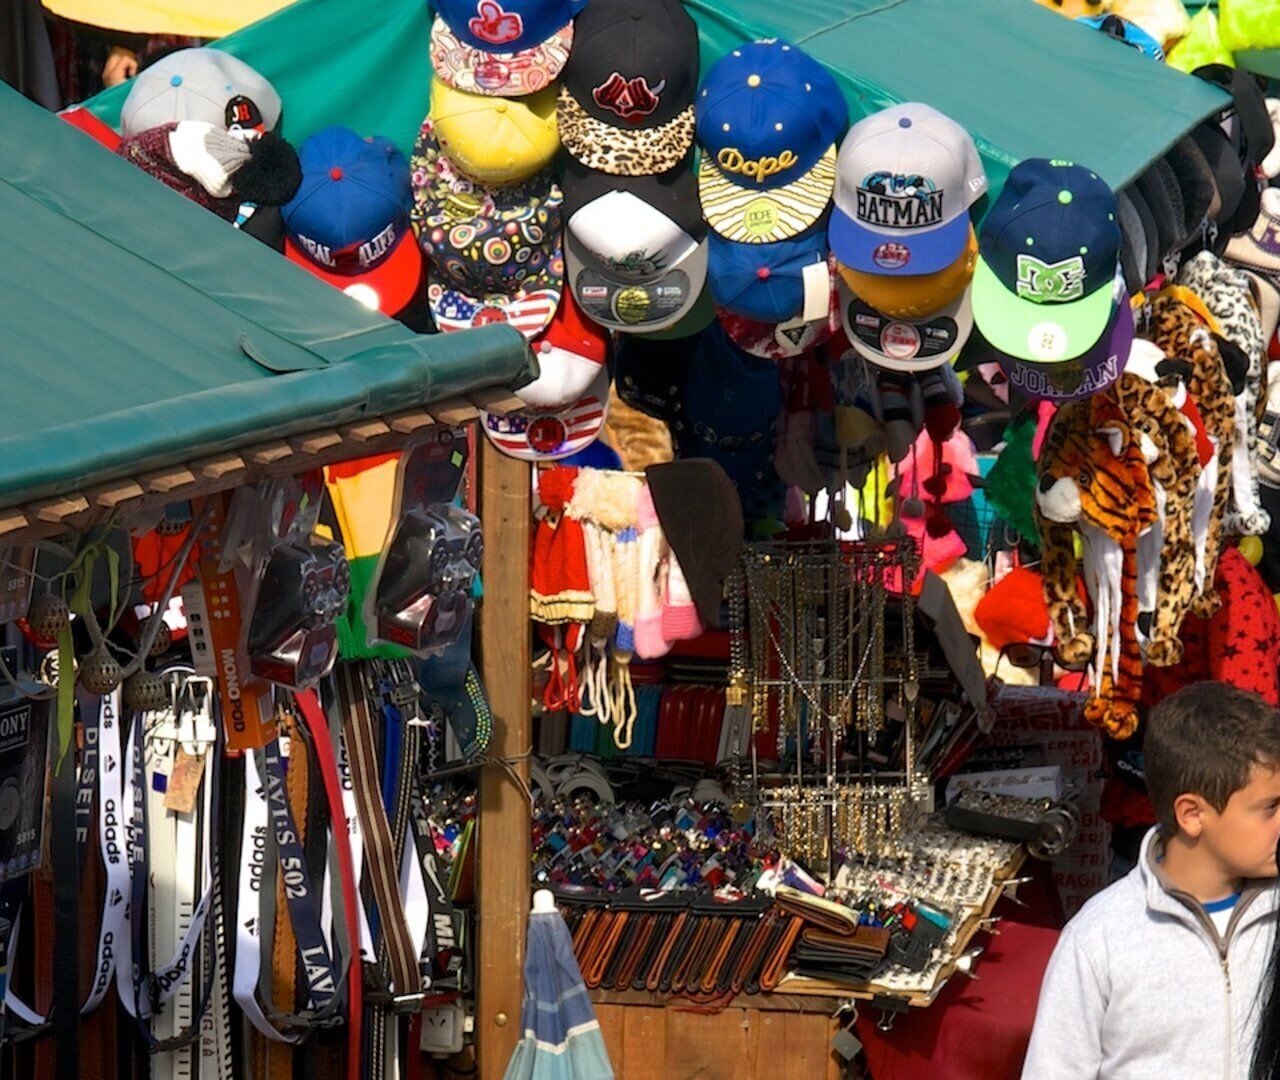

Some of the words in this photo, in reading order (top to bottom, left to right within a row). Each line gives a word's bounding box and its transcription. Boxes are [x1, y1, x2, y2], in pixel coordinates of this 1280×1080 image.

[717, 147, 798, 184] Dope
[856, 192, 944, 226] BATMAN
[221, 648, 246, 733] MONOPOD
[104, 799, 121, 865] adads
[281, 857, 308, 900] 502
[159, 943, 191, 993] adad
